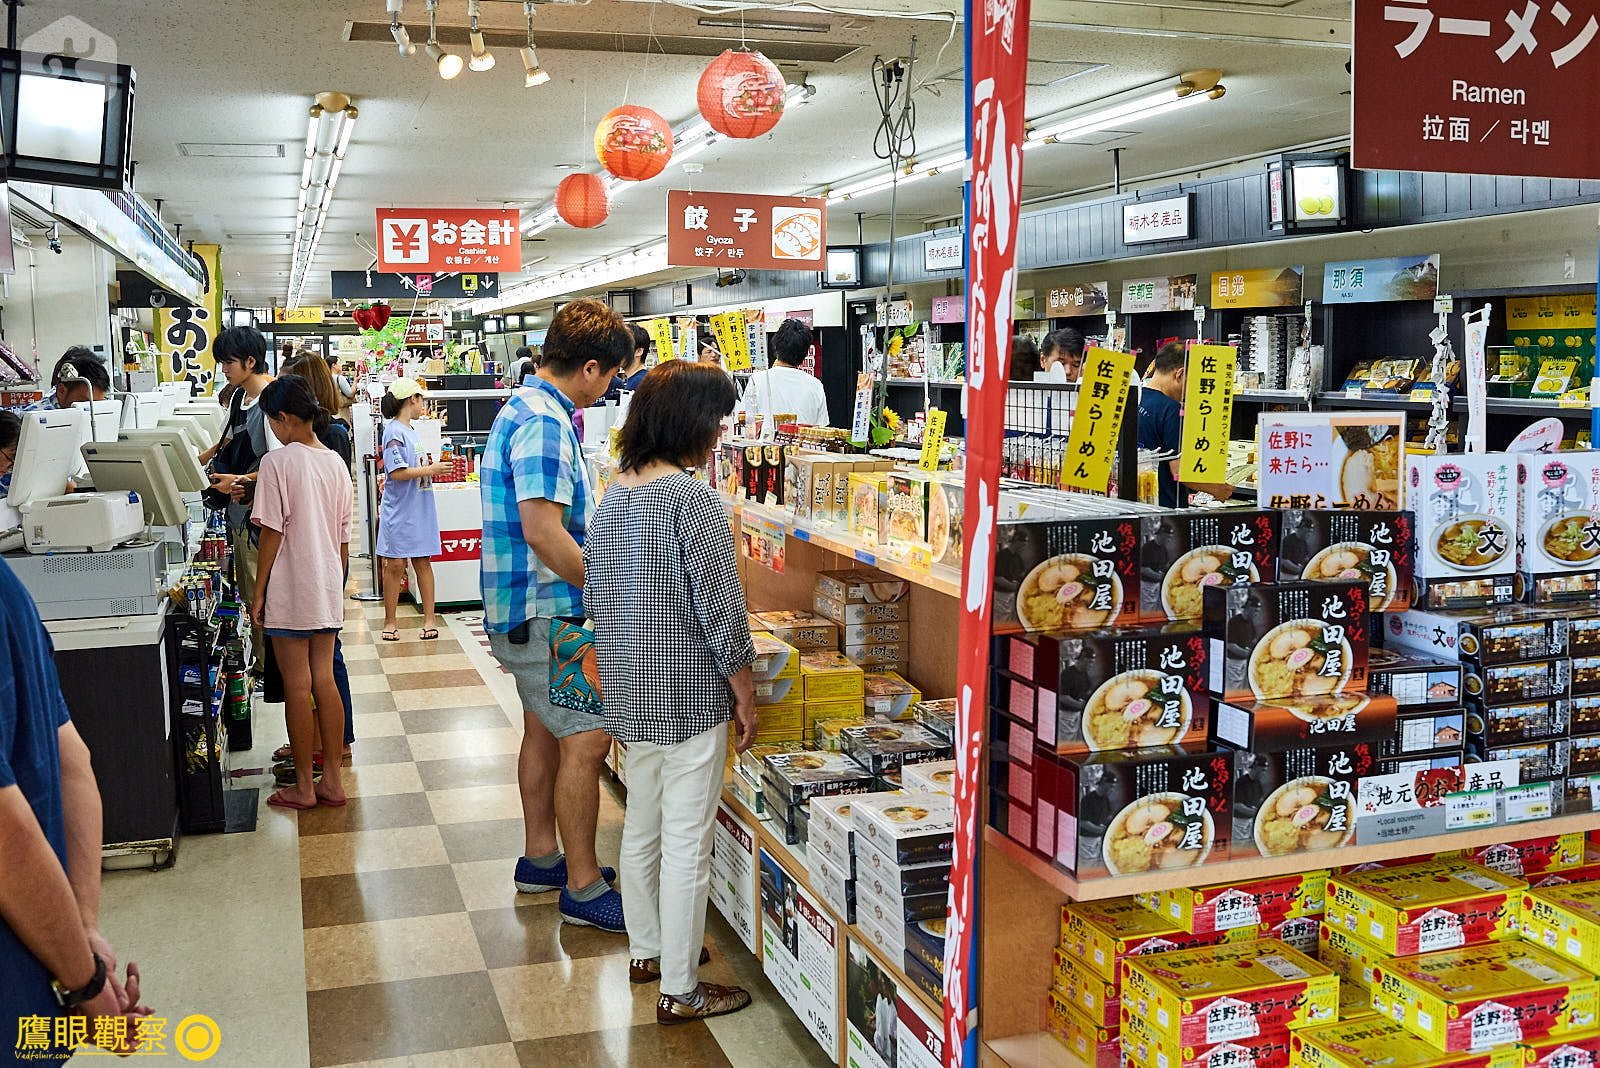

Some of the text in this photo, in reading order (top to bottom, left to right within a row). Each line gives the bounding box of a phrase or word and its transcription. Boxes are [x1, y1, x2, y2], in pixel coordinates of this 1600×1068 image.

[1384, 0, 1598, 68] ラーメン
[1453, 80, 1526, 105] Ramen
[1423, 115, 1470, 142] 拉面
[1511, 119, 1550, 145] 라멘
[684, 206, 758, 232] 餃子
[1129, 209, 1182, 231] 栃木名産品
[431, 219, 515, 246] お会計
[707, 235, 734, 246] Gyoza
[458, 247, 488, 256] Cashier
[1218, 275, 1245, 297] 日光
[1332, 267, 1365, 290] 那須
[1128, 283, 1153, 301] 宇都宮
[1074, 359, 1115, 478] 佐野らーめん
[1193, 356, 1217, 474] 佐野らーめん
[1268, 431, 1313, 450] 佐野に
[1476, 525, 1506, 555] 文
[1088, 530, 1117, 611] 池田屋
[1367, 522, 1393, 598] 池田屋
[1317, 595, 1346, 678] 池田屋
[1432, 625, 1447, 648] 文
[1155, 644, 1187, 729] 池田屋
[1308, 713, 1356, 736] 池田屋
[1323, 751, 1353, 833] 池田屋
[1376, 771, 1504, 807] 地元のお土産品
[1177, 766, 1209, 850] 池田屋
[1337, 886, 1354, 901] 佐野
[1534, 901, 1553, 917] 佐野
[1130, 968, 1144, 985] 佐野
[1384, 974, 1401, 989] 佐野
